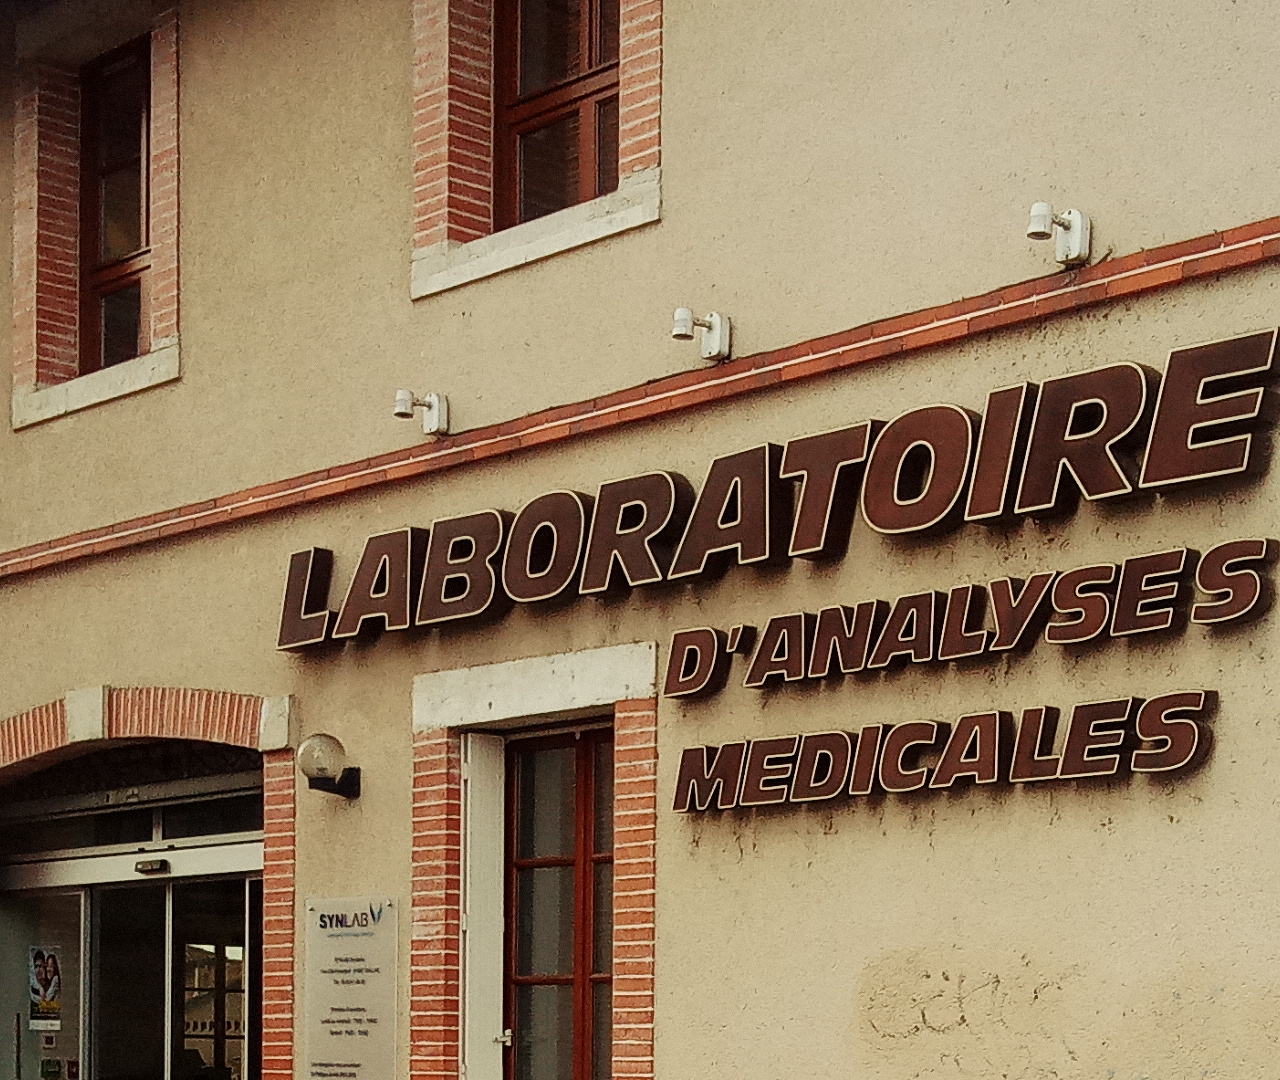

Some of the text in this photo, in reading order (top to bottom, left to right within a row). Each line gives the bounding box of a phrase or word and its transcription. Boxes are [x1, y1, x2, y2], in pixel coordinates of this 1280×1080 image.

[662, 538, 1280, 699] D'ANALYSES
[672, 689, 1217, 813] MEDICALES
[319, 912, 369, 929] SYNLAB
